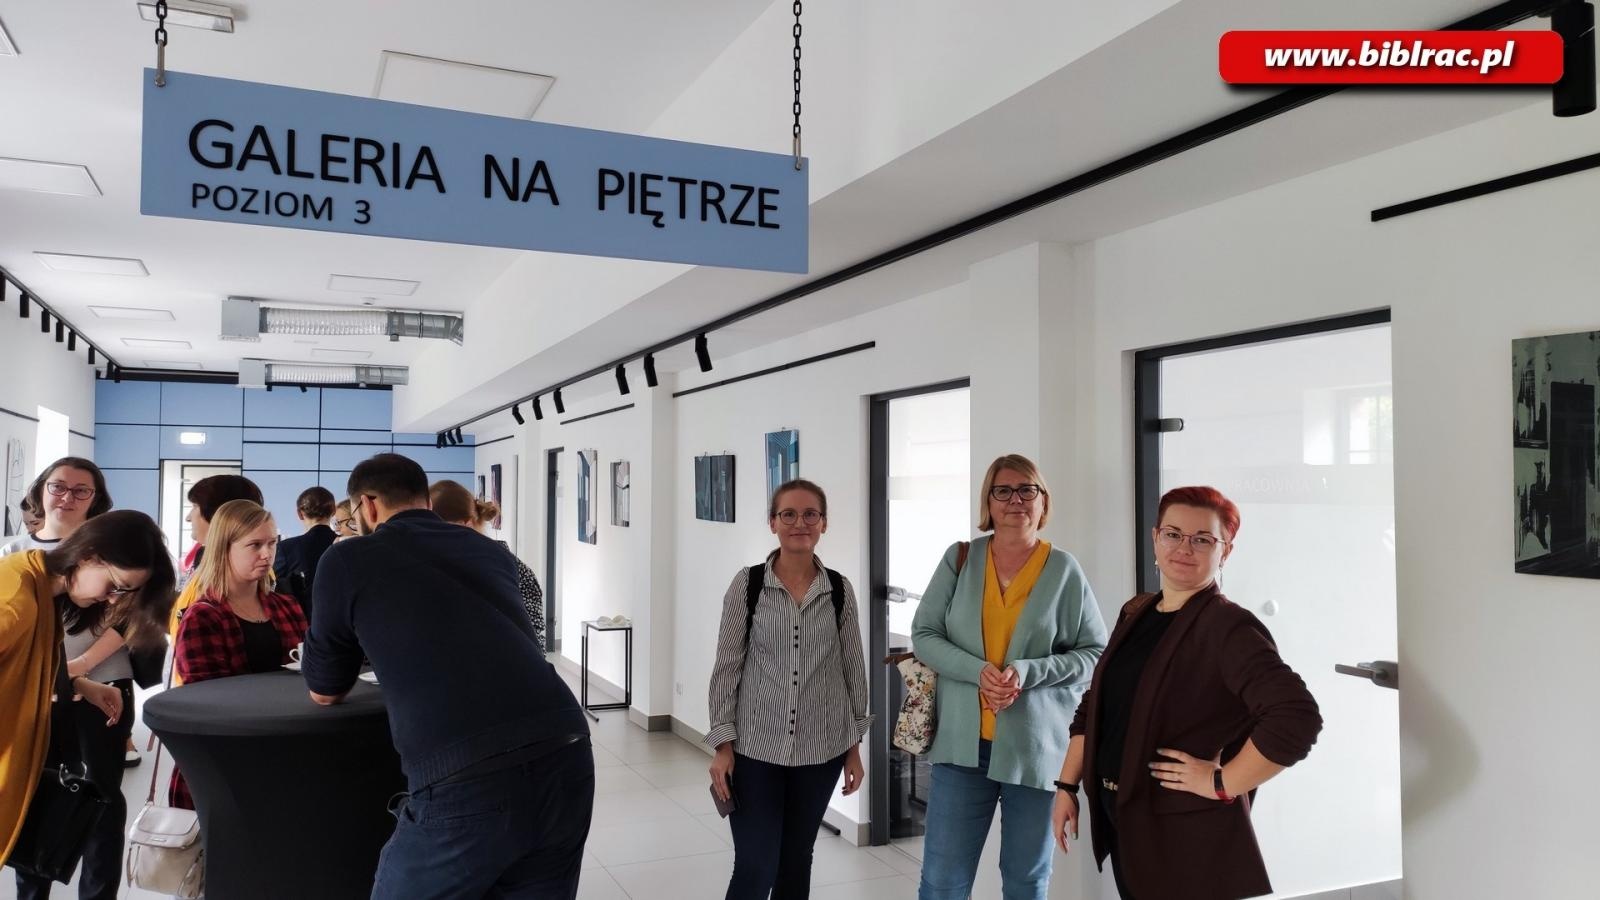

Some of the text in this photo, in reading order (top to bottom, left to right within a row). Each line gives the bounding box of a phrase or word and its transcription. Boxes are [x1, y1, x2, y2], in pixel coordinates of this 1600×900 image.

[188, 118, 781, 230] GALERIA NA PIĘTRZE
[191, 182, 372, 225] POZIOM 3
